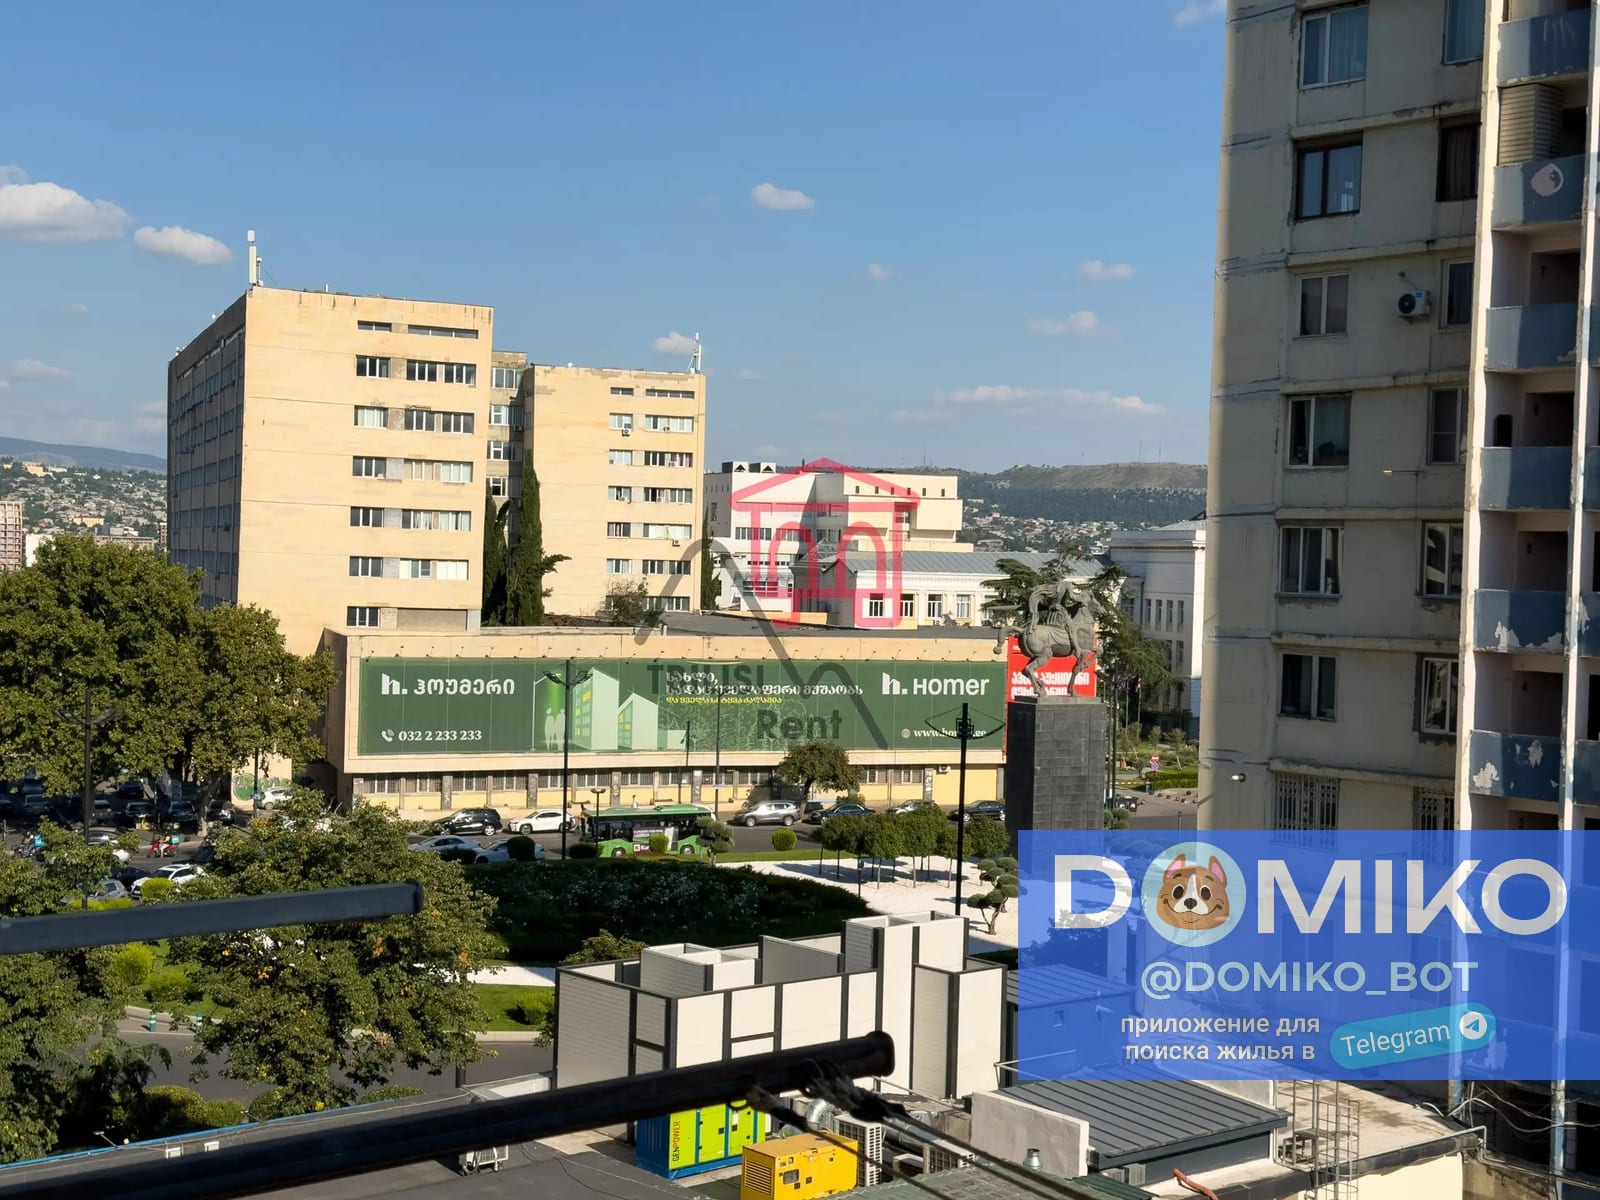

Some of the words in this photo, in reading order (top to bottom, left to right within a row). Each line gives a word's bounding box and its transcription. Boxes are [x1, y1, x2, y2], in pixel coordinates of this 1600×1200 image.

[398, 730, 422, 741] 032
[425, 730, 432, 741] 2
[435, 730, 457, 741] 233
[460, 730, 482, 740] 233
